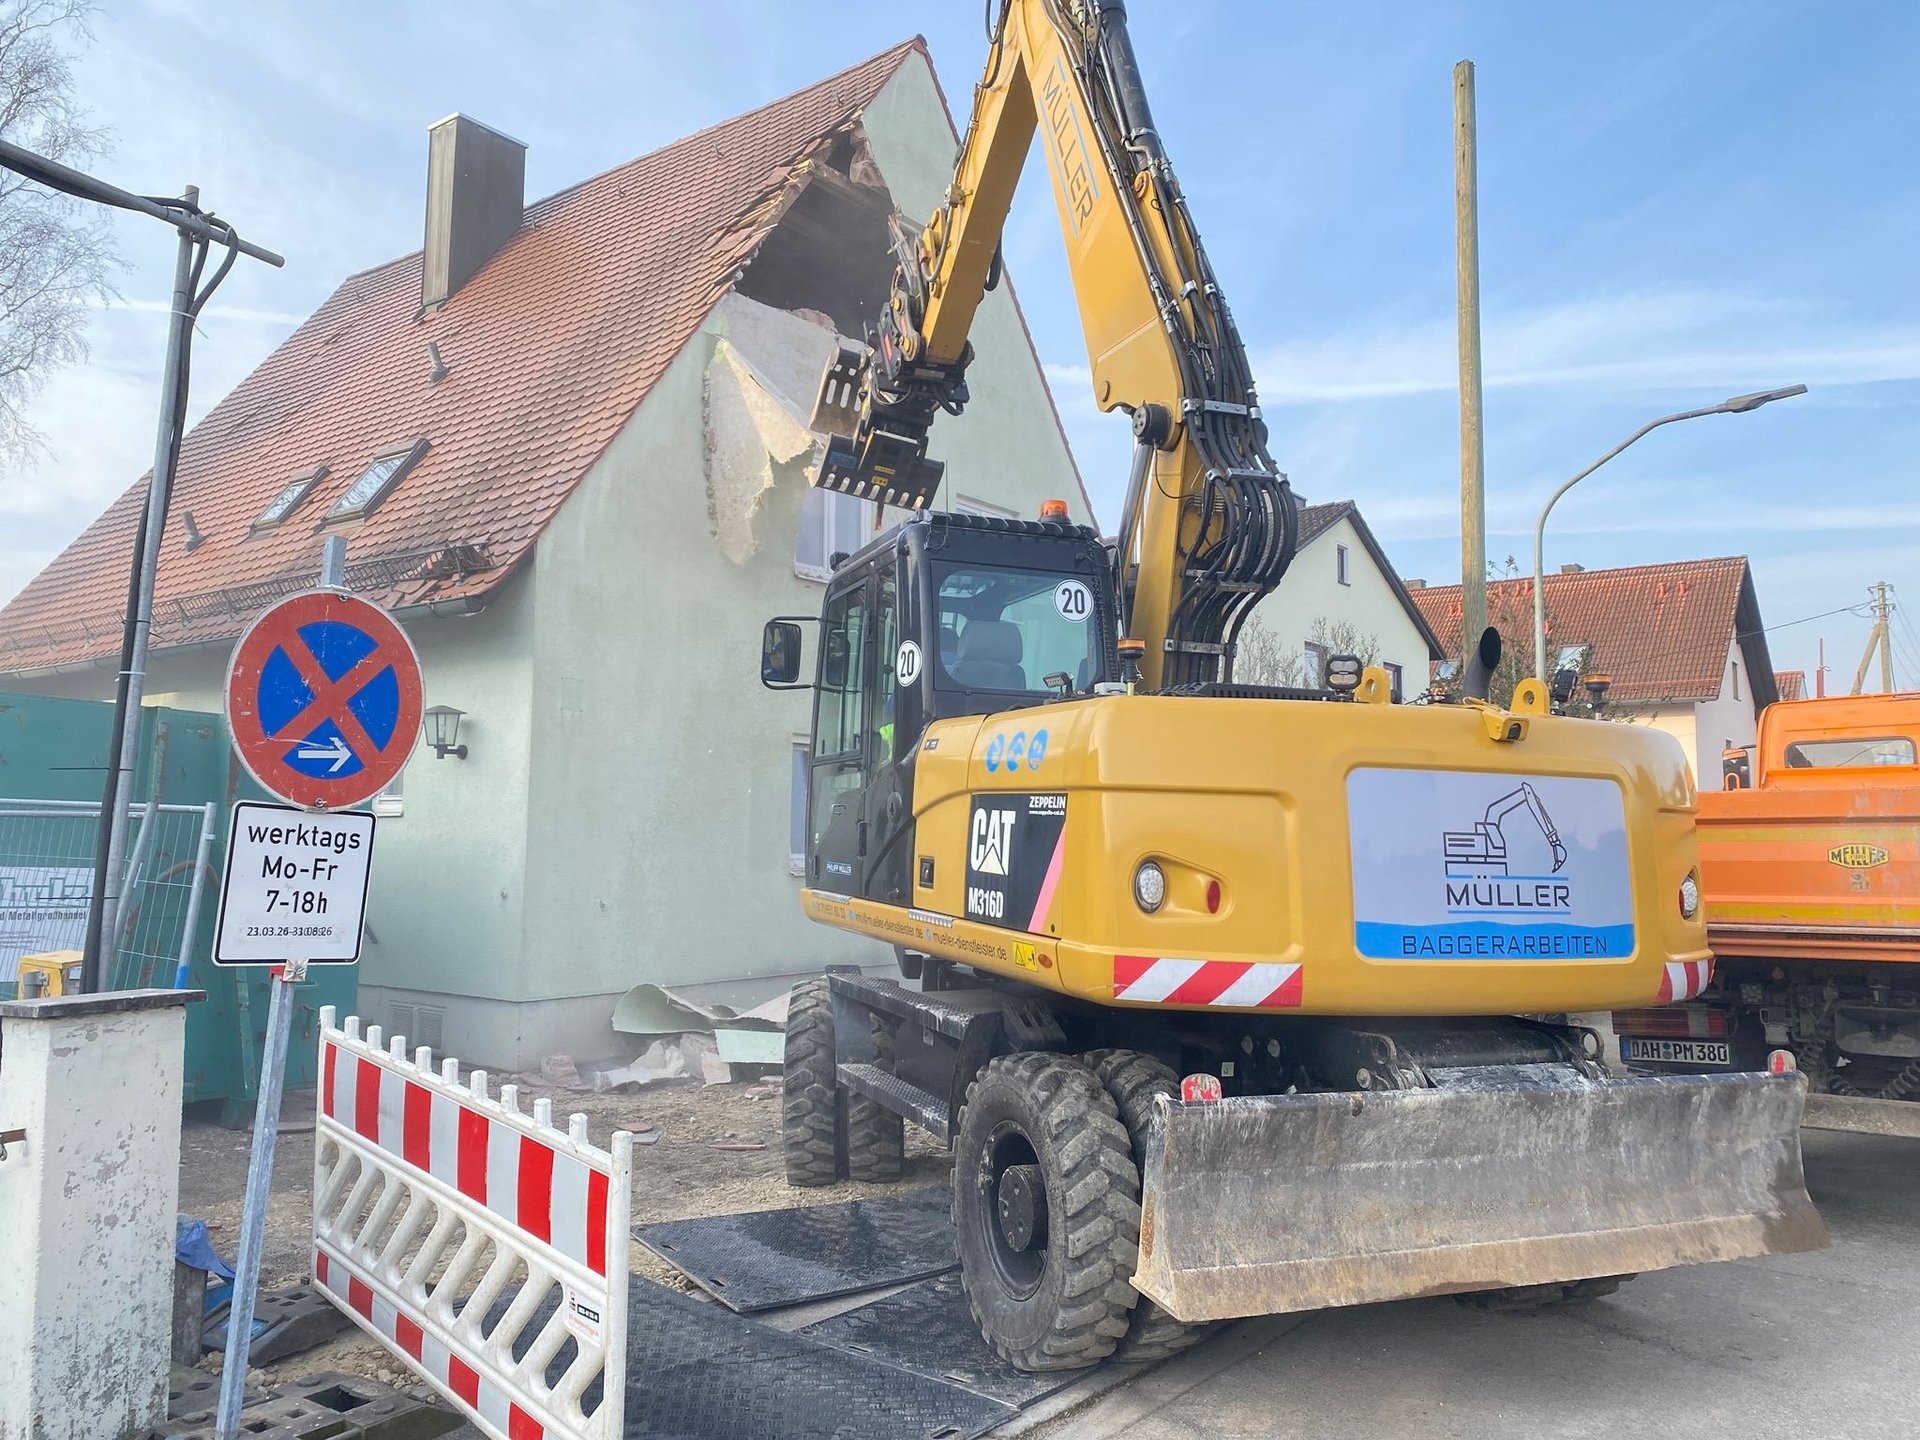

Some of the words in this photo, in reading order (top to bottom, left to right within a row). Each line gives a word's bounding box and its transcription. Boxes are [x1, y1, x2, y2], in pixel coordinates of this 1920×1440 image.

[1043, 65, 1093, 228] MÜLLER
[1062, 587, 1085, 615] 20
[900, 649, 915, 677] 20
[1029, 795, 1066, 808] ZEPPELIN
[248, 823, 361, 854] werktags
[970, 808, 1016, 876] CAT
[262, 855, 339, 881] Mo-Fr
[266, 890, 328, 914] 7-18h
[968, 887, 1004, 918] M316D
[1446, 875, 1571, 907] MÜLLER
[1402, 935, 1608, 955] BAGGERARBEITEN
[1632, 1041, 1661, 1059] DAH
[1673, 1043, 1694, 1060] PM
[1696, 1044, 1728, 1062] 380
